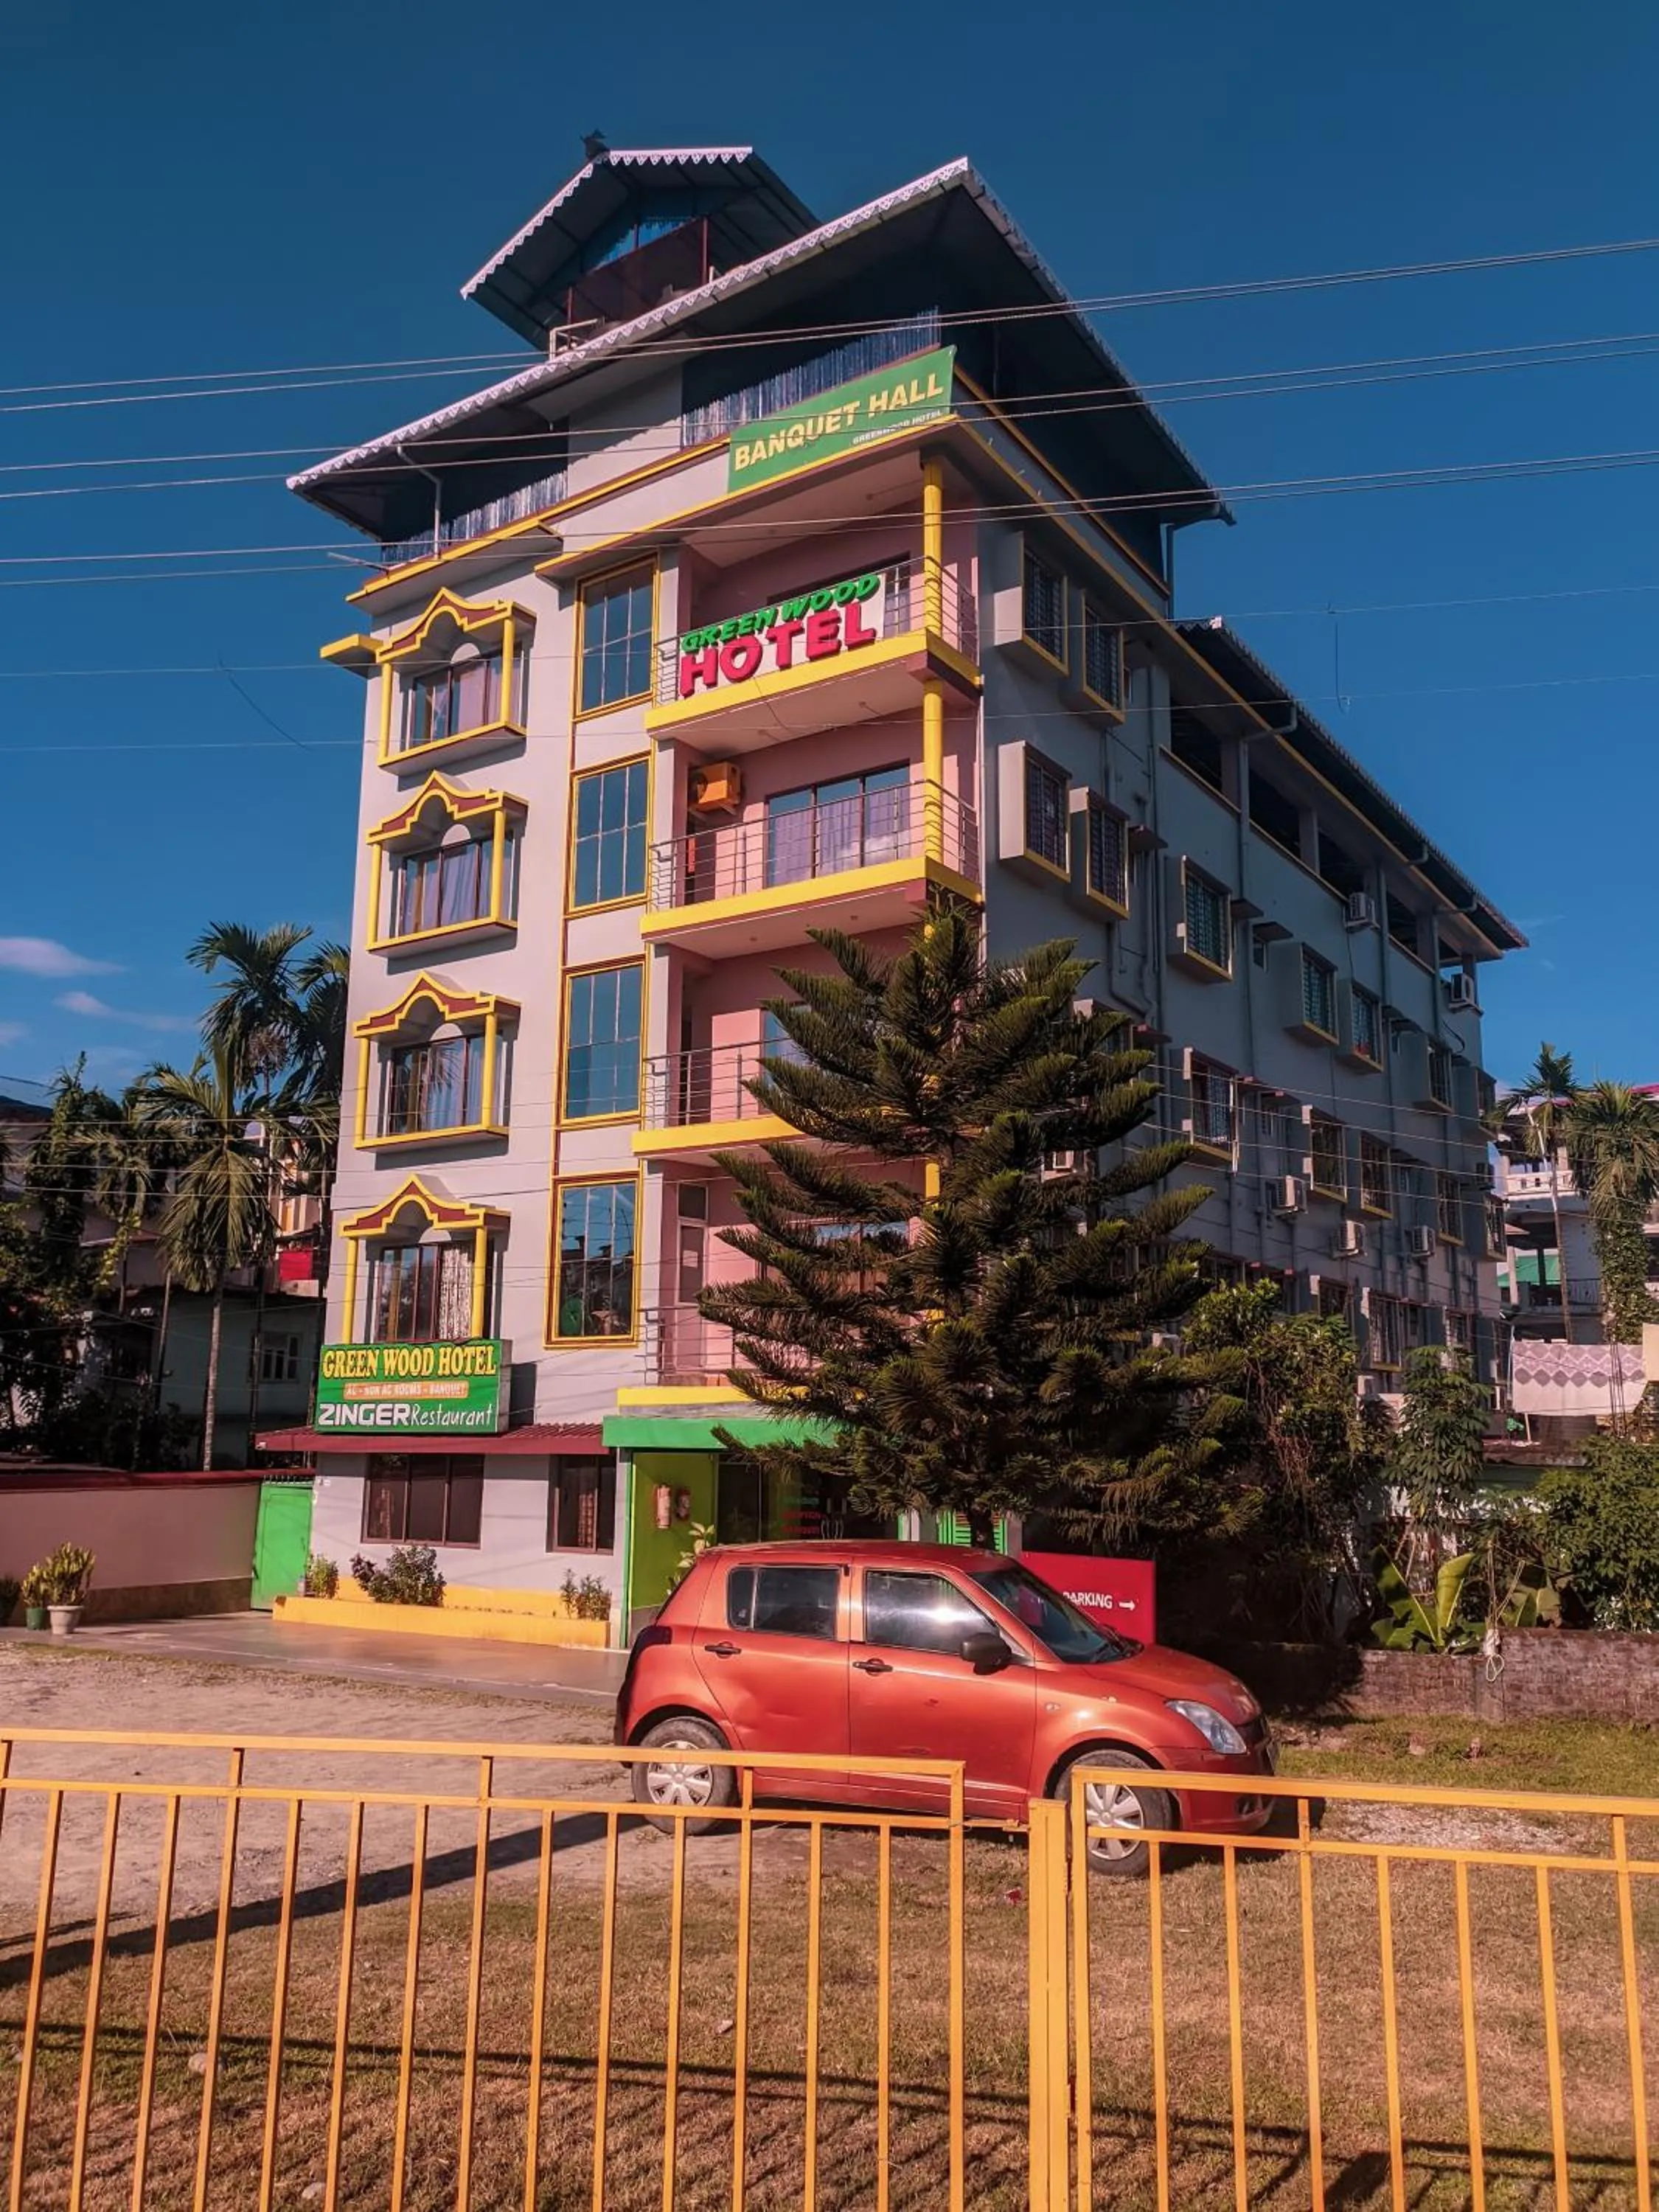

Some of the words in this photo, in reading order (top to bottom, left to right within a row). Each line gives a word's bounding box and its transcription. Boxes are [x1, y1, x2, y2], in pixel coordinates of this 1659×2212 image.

[735, 400, 860, 471] BANQUET
[869, 373, 944, 417] HALL
[911, 409, 941, 425] HOTEL
[681, 606, 778, 653] GREEN
[781, 573, 880, 622] WOOD
[680, 602, 877, 698] HOTEL
[323, 1349, 380, 1378] GREEN
[383, 1347, 434, 1376] WOOD
[437, 1345, 496, 1376] HOTEL
[319, 1404, 411, 1425] ZINGER
[411, 1403, 493, 1426] Restaurant
